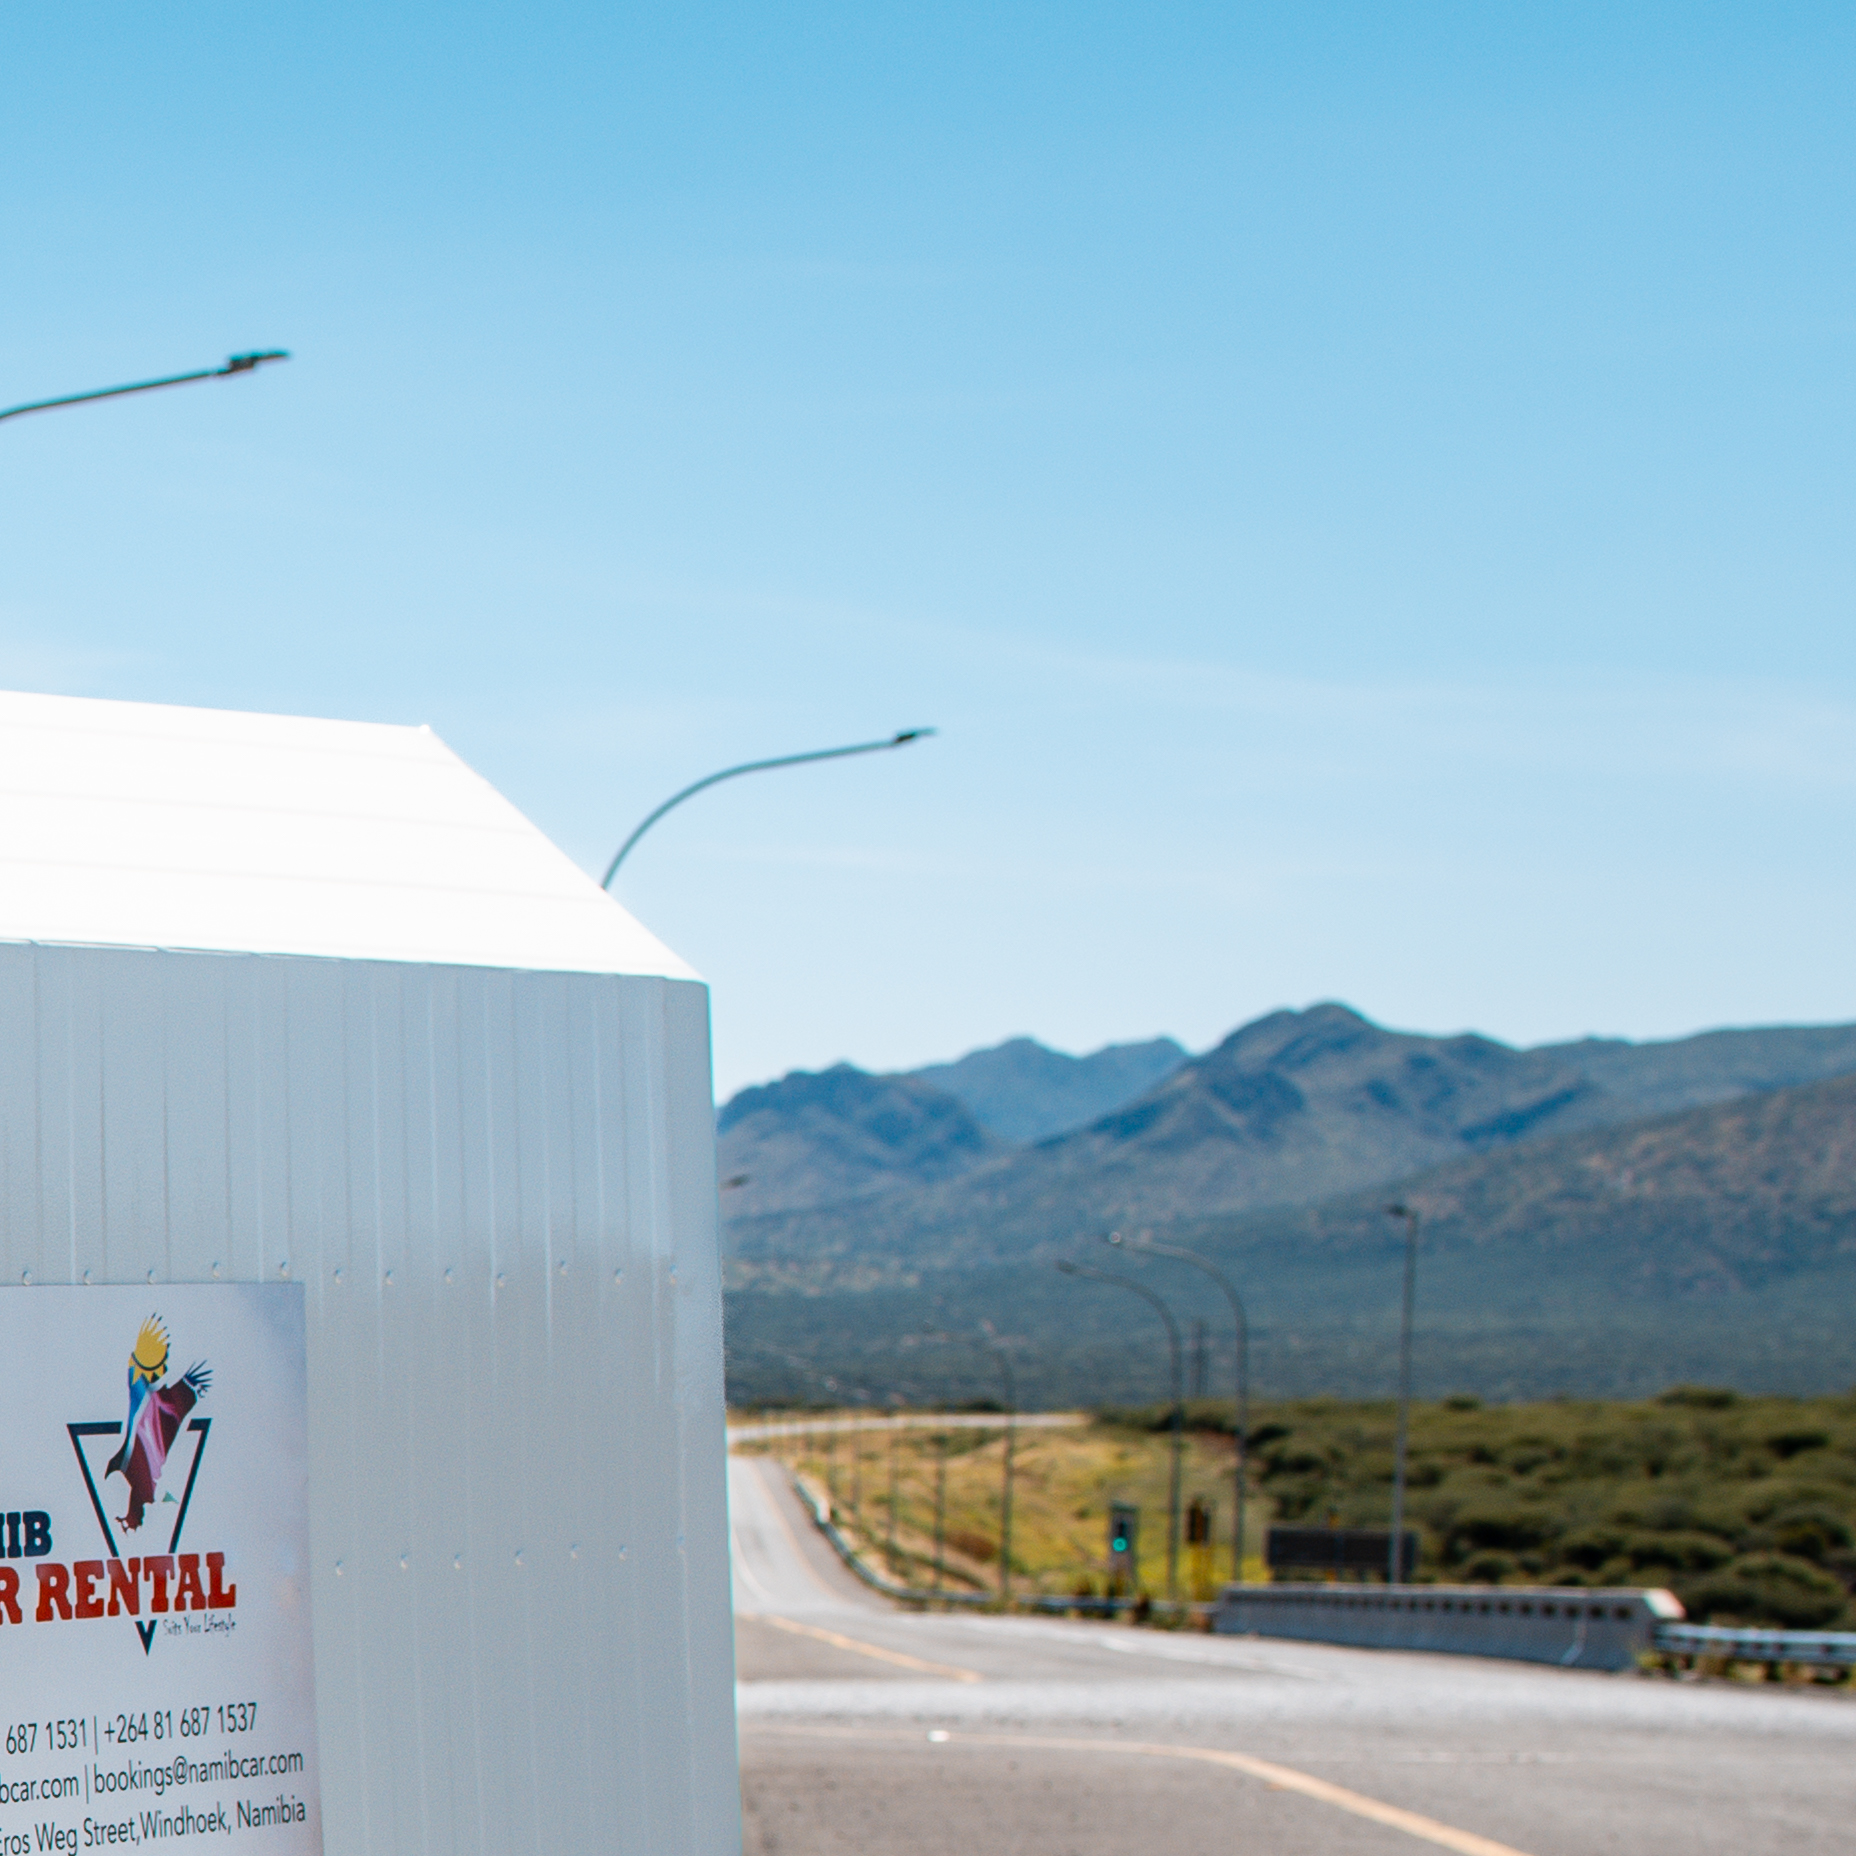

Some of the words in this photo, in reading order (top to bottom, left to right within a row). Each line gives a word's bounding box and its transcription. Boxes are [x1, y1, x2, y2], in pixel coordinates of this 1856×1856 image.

[35, 1552, 236, 1622] RENTAL
[6, 1723, 37, 1755] 687
[45, 1718, 86, 1750] 1531
[104, 1713, 148, 1743] +264
[154, 1710, 172, 1740] 81
[180, 1707, 210, 1737] 687
[217, 1702, 257, 1733] 1537
[94, 1749, 303, 1796] bookings@namibcar.com
[35, 1822, 78, 1856] Weg
[237, 1794, 306, 1828] Namibia
